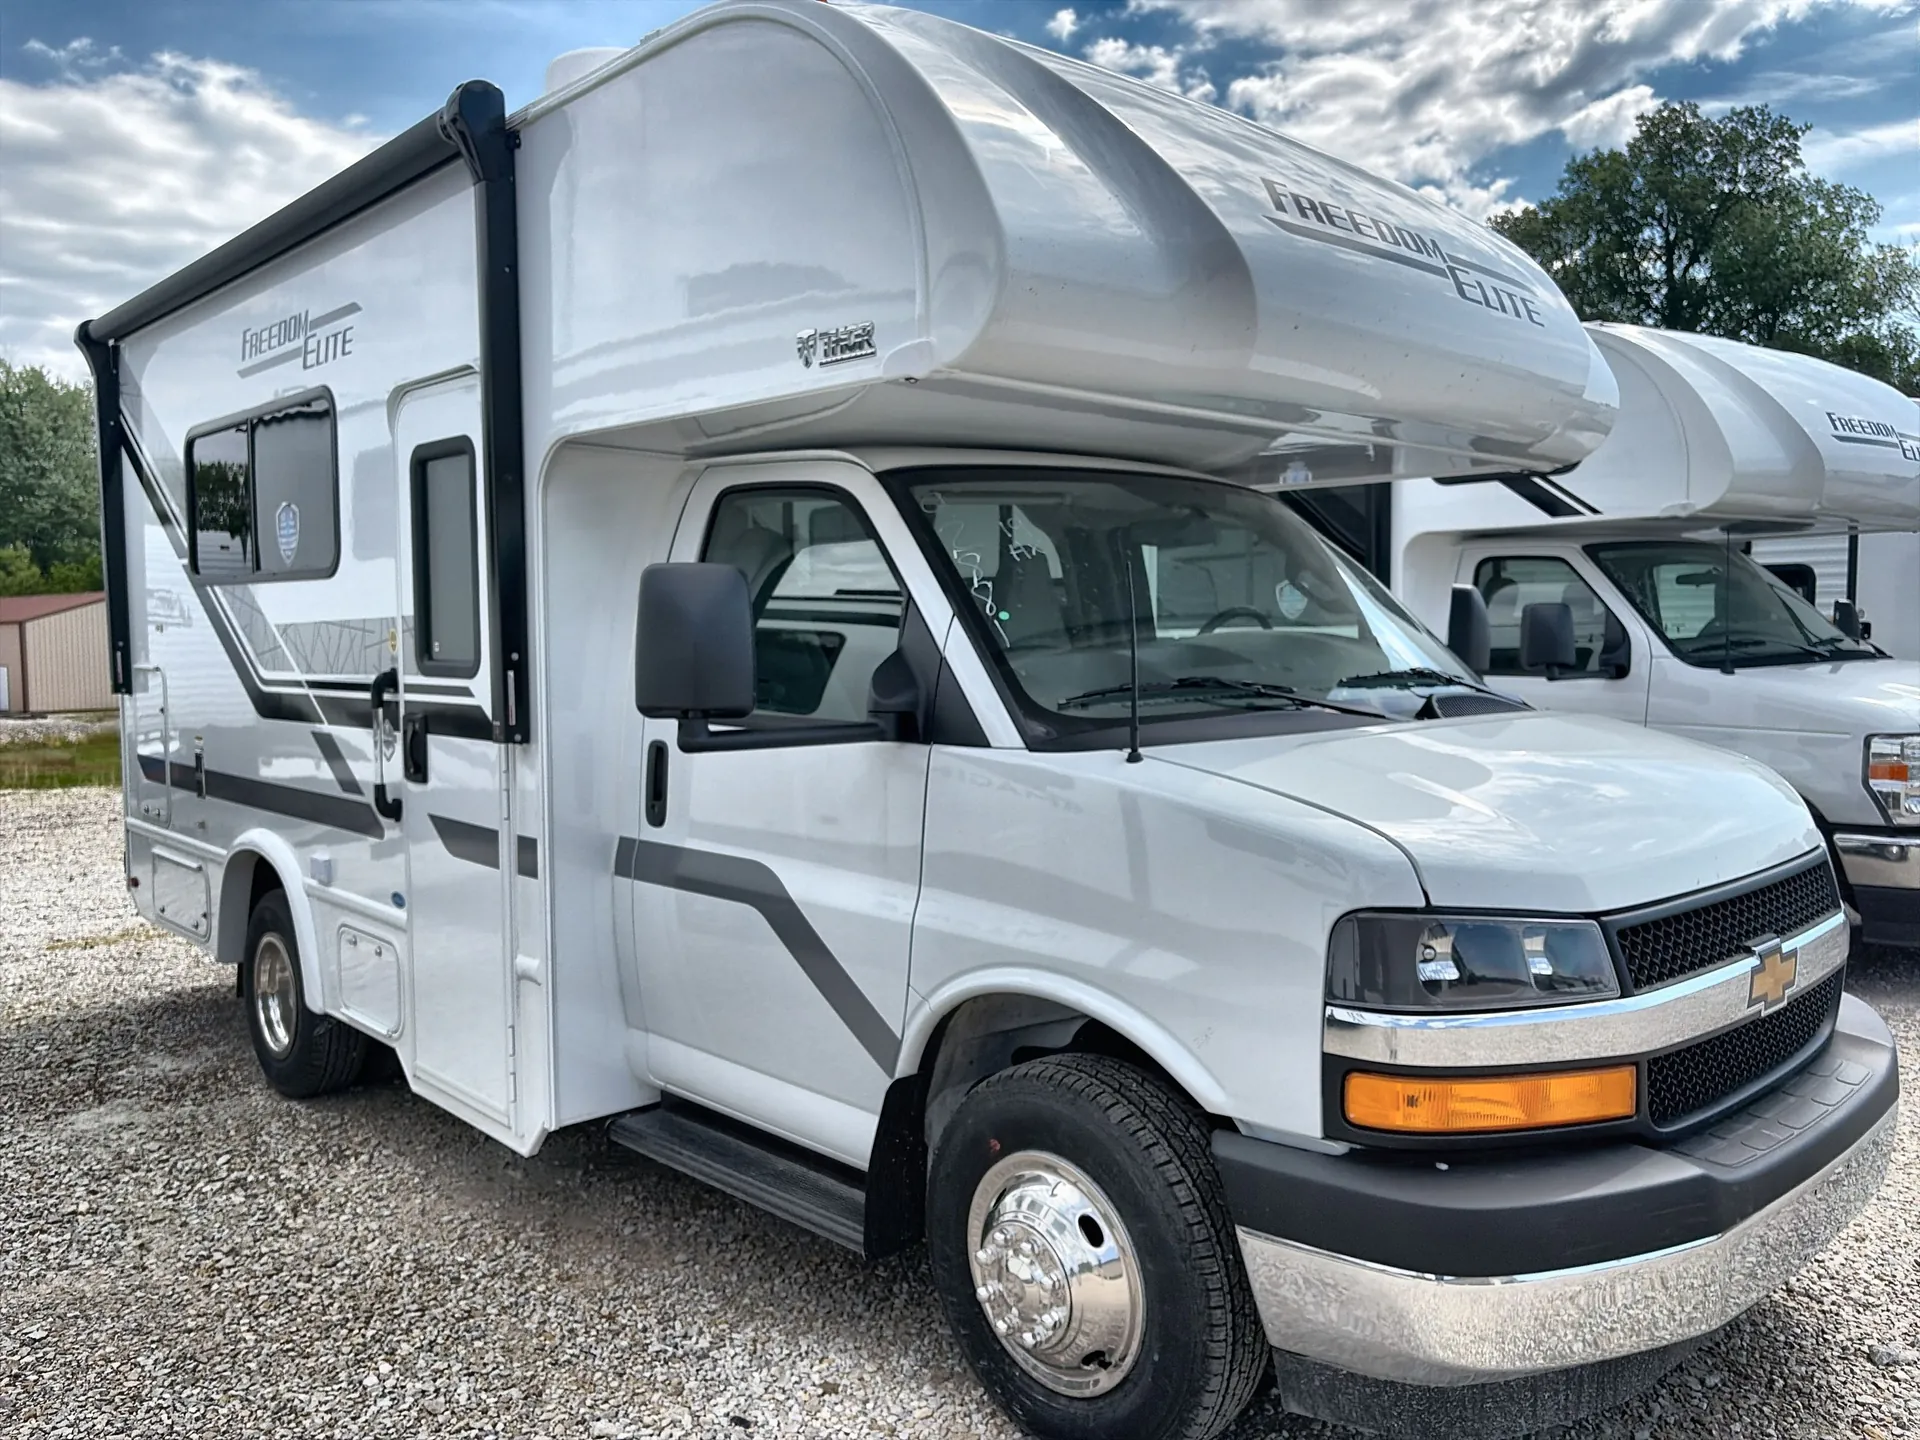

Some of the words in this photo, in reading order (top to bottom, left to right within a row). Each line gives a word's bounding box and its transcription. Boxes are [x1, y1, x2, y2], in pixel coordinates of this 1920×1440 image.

[1260, 177, 1449, 264] FREEDOM
[1445, 264, 1546, 328] ELITE
[241, 308, 309, 362] FREEDOM
[302, 325, 354, 371] ELITE
[1825, 411, 1900, 441] FREEDOM
